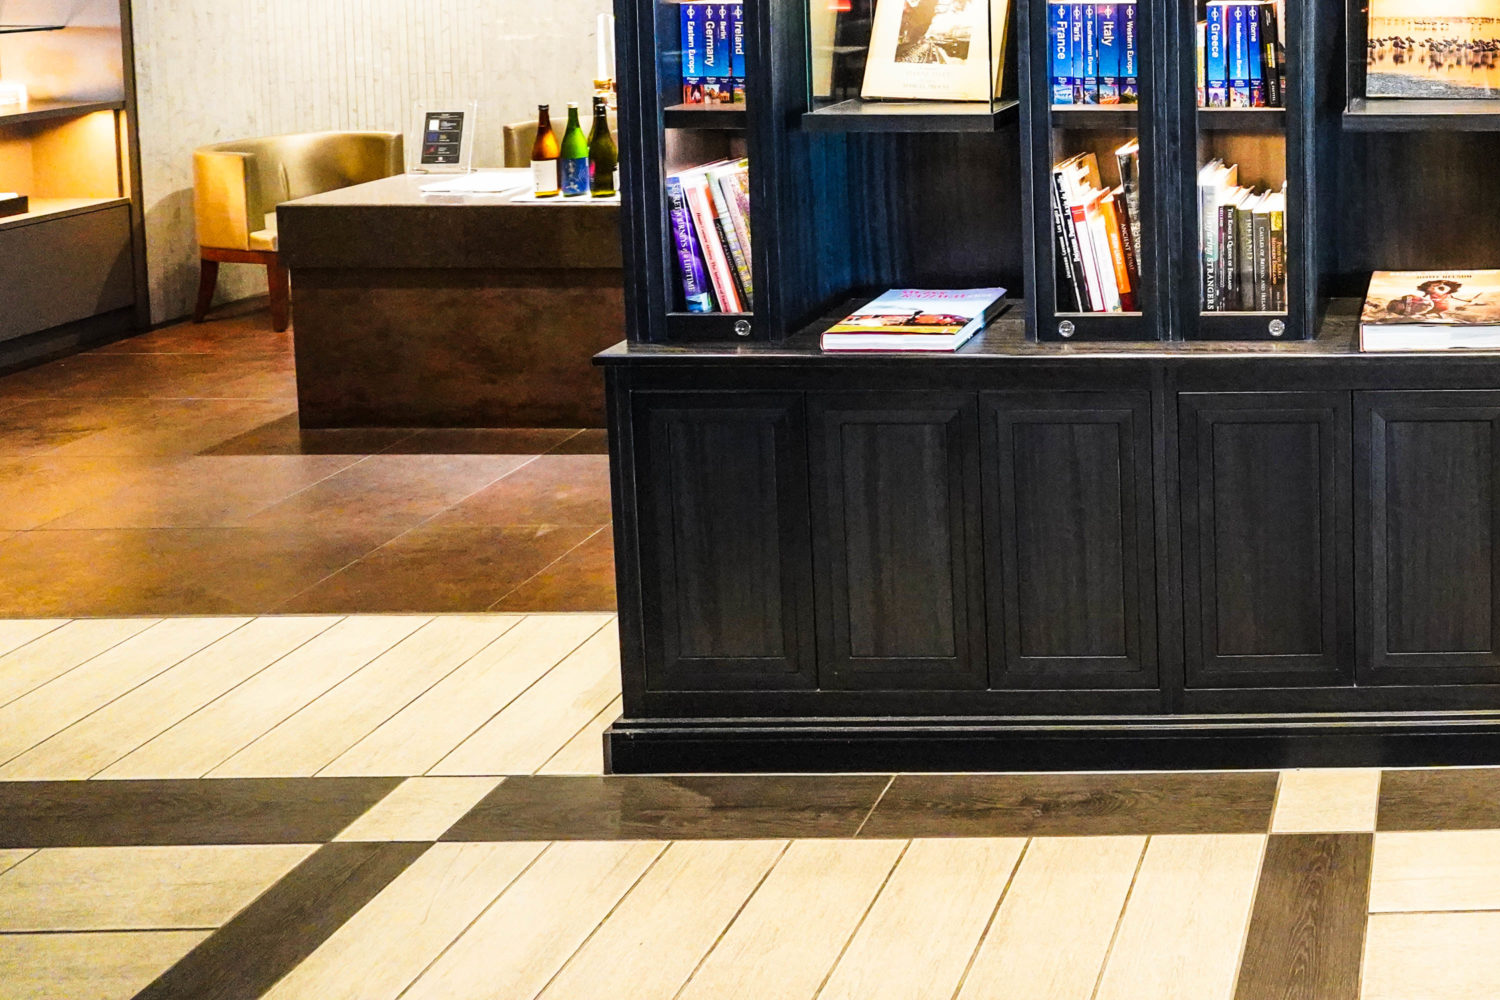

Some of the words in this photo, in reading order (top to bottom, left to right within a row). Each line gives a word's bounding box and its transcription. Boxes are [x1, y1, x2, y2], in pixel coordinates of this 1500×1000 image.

[687, 21, 695, 48] Eastern
[705, 21, 715, 67] Germany
[734, 21, 744, 55] Ireland
[1056, 21, 1067, 60] France
[1073, 21, 1081, 42] Paris
[1102, 21, 1114, 47] Italy
[1126, 21, 1134, 49] Western
[1211, 23, 1220, 58] Greece
[687, 49, 696, 74] Europe
[1226, 240, 1234, 260] QUEENS
[1245, 217, 1253, 260] IRELAND
[1206, 257, 1214, 310] STRANGERS
